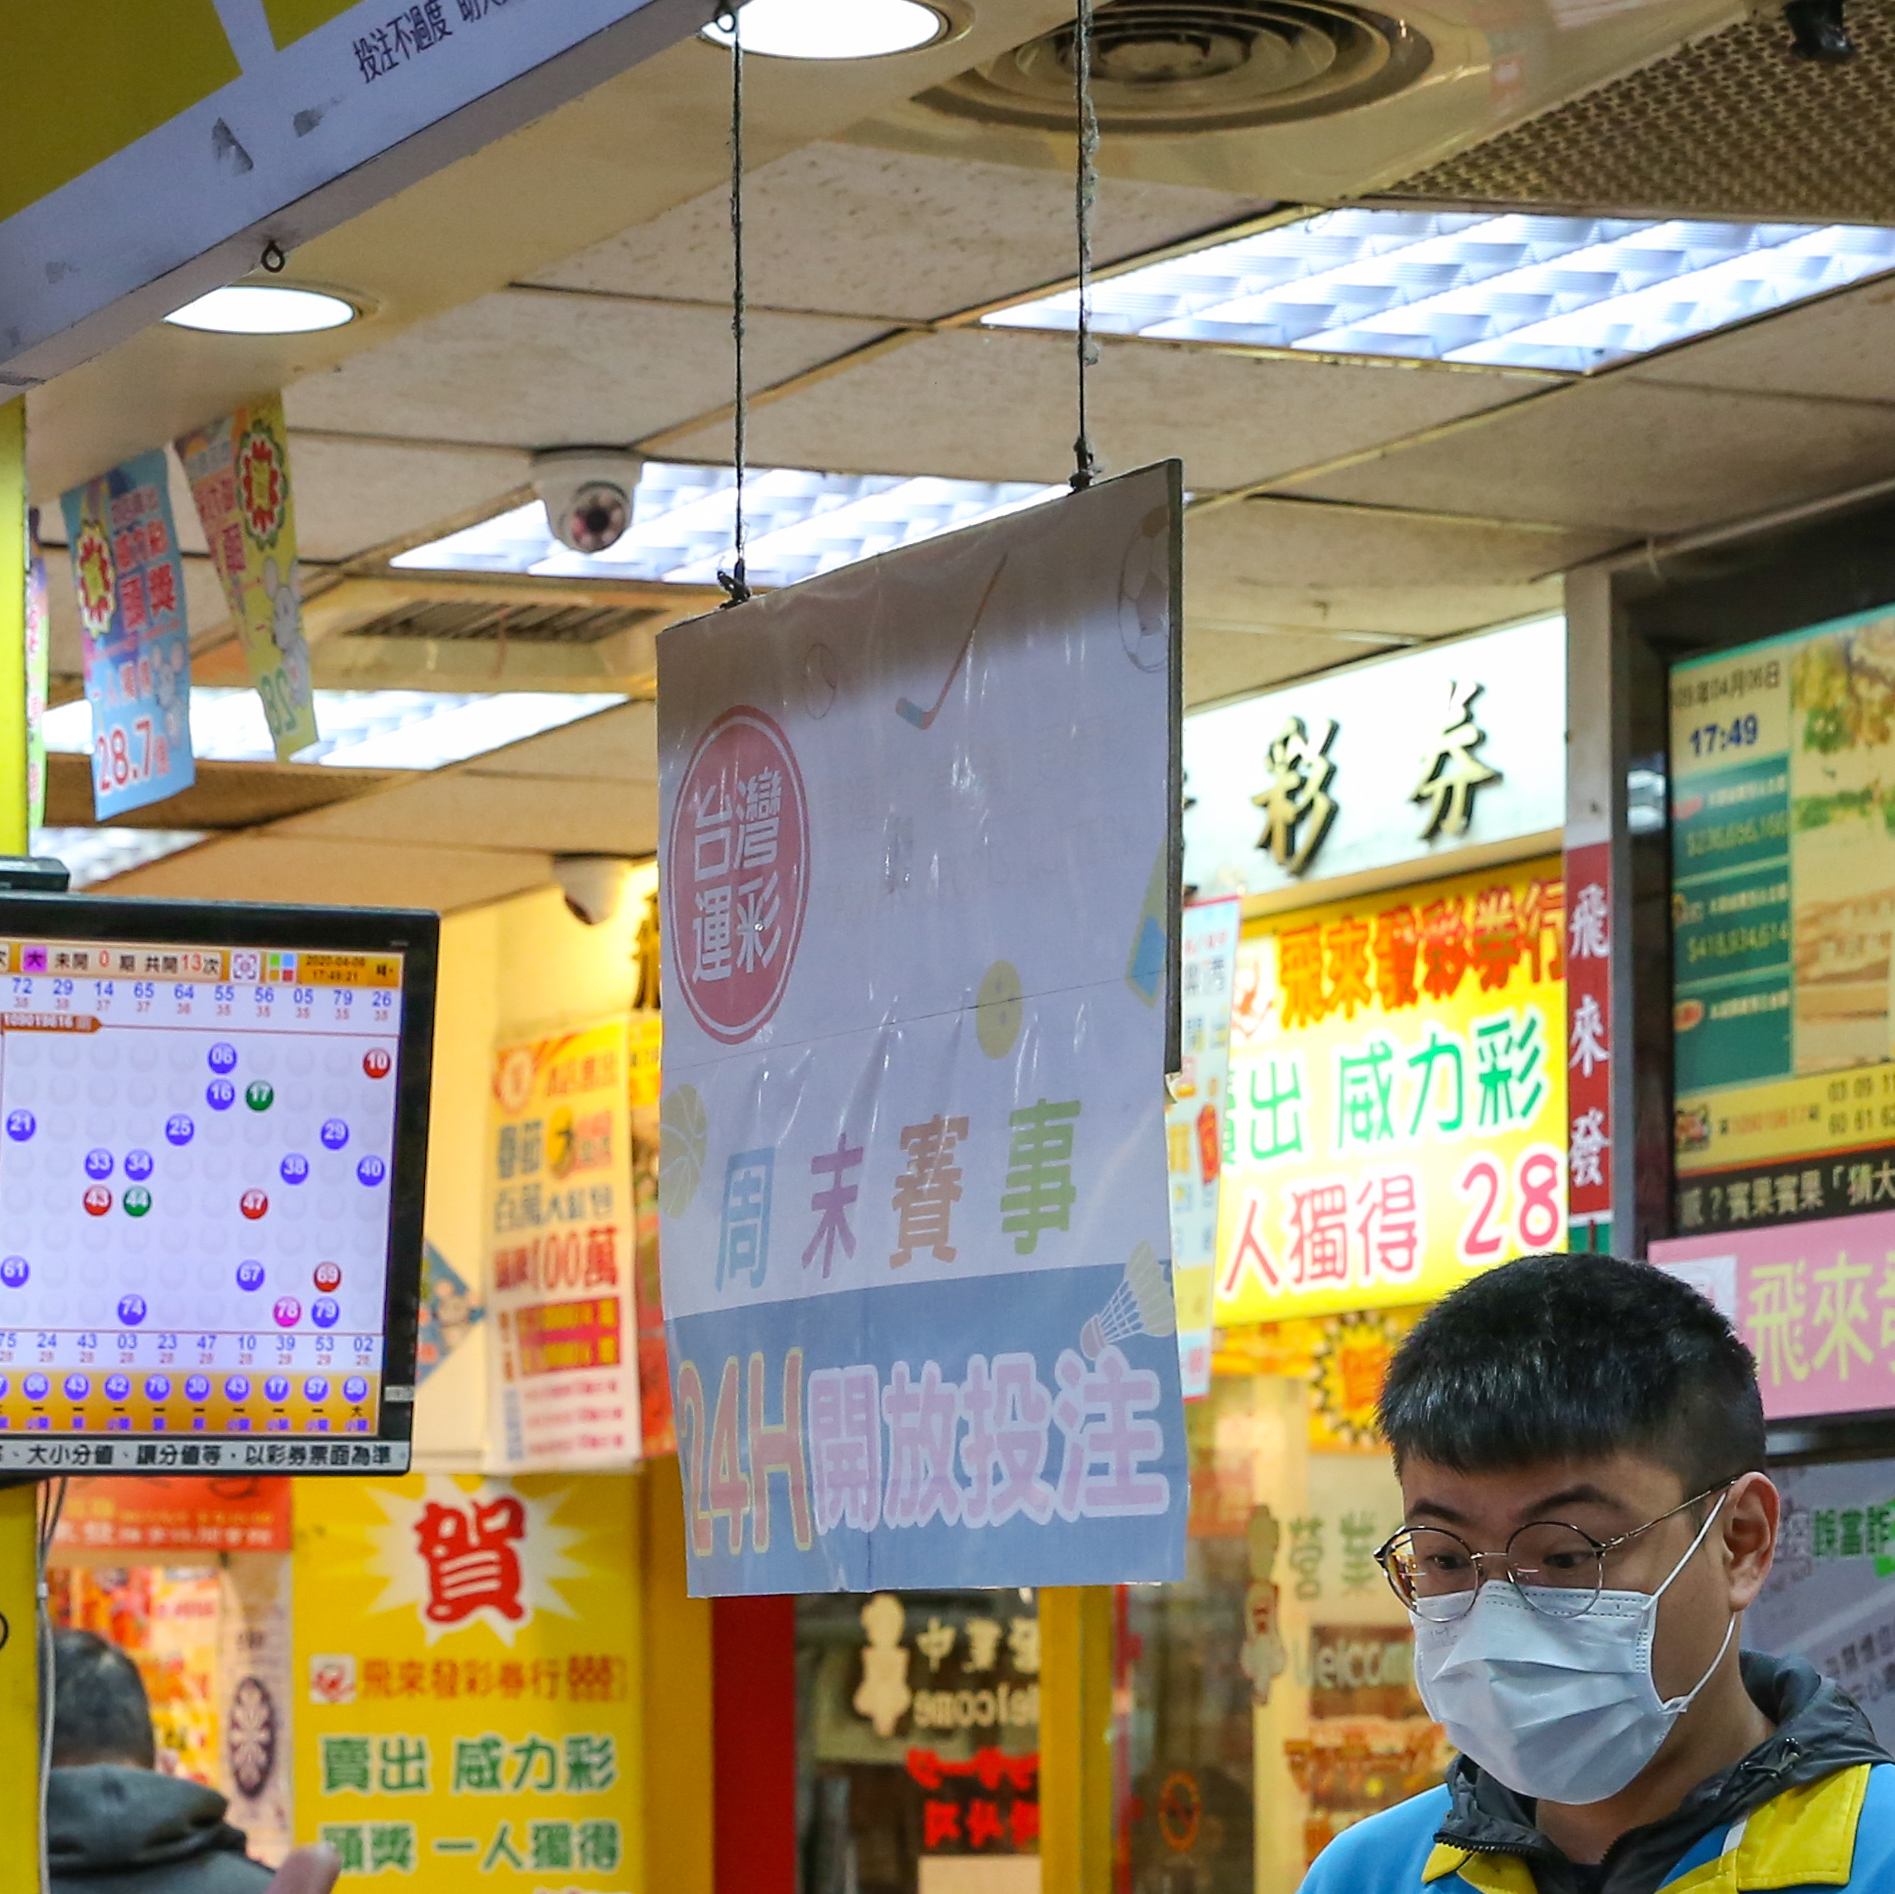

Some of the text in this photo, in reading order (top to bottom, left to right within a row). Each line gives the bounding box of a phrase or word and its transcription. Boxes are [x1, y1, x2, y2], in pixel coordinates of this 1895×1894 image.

[1689, 714, 1759, 756] 17:49
[691, 766, 783, 860] 台灣
[691, 881, 783, 984] 運彩
[1278, 879, 1564, 1029] 飛來發彩券行
[1338, 1015, 1544, 1152] 威力彩
[1568, 881, 1610, 1190] 飛來發
[714, 1096, 1083, 1293] 周末賽事
[1224, 1151, 1560, 1296] 人獨得 28
[677, 1348, 1171, 1556] 24H開放投注
[416, 1497, 528, 1626] 賀
[321, 1737, 616, 1793] 賣出 威力彩
[322, 1821, 621, 1873] 頭獎 一人獨得
